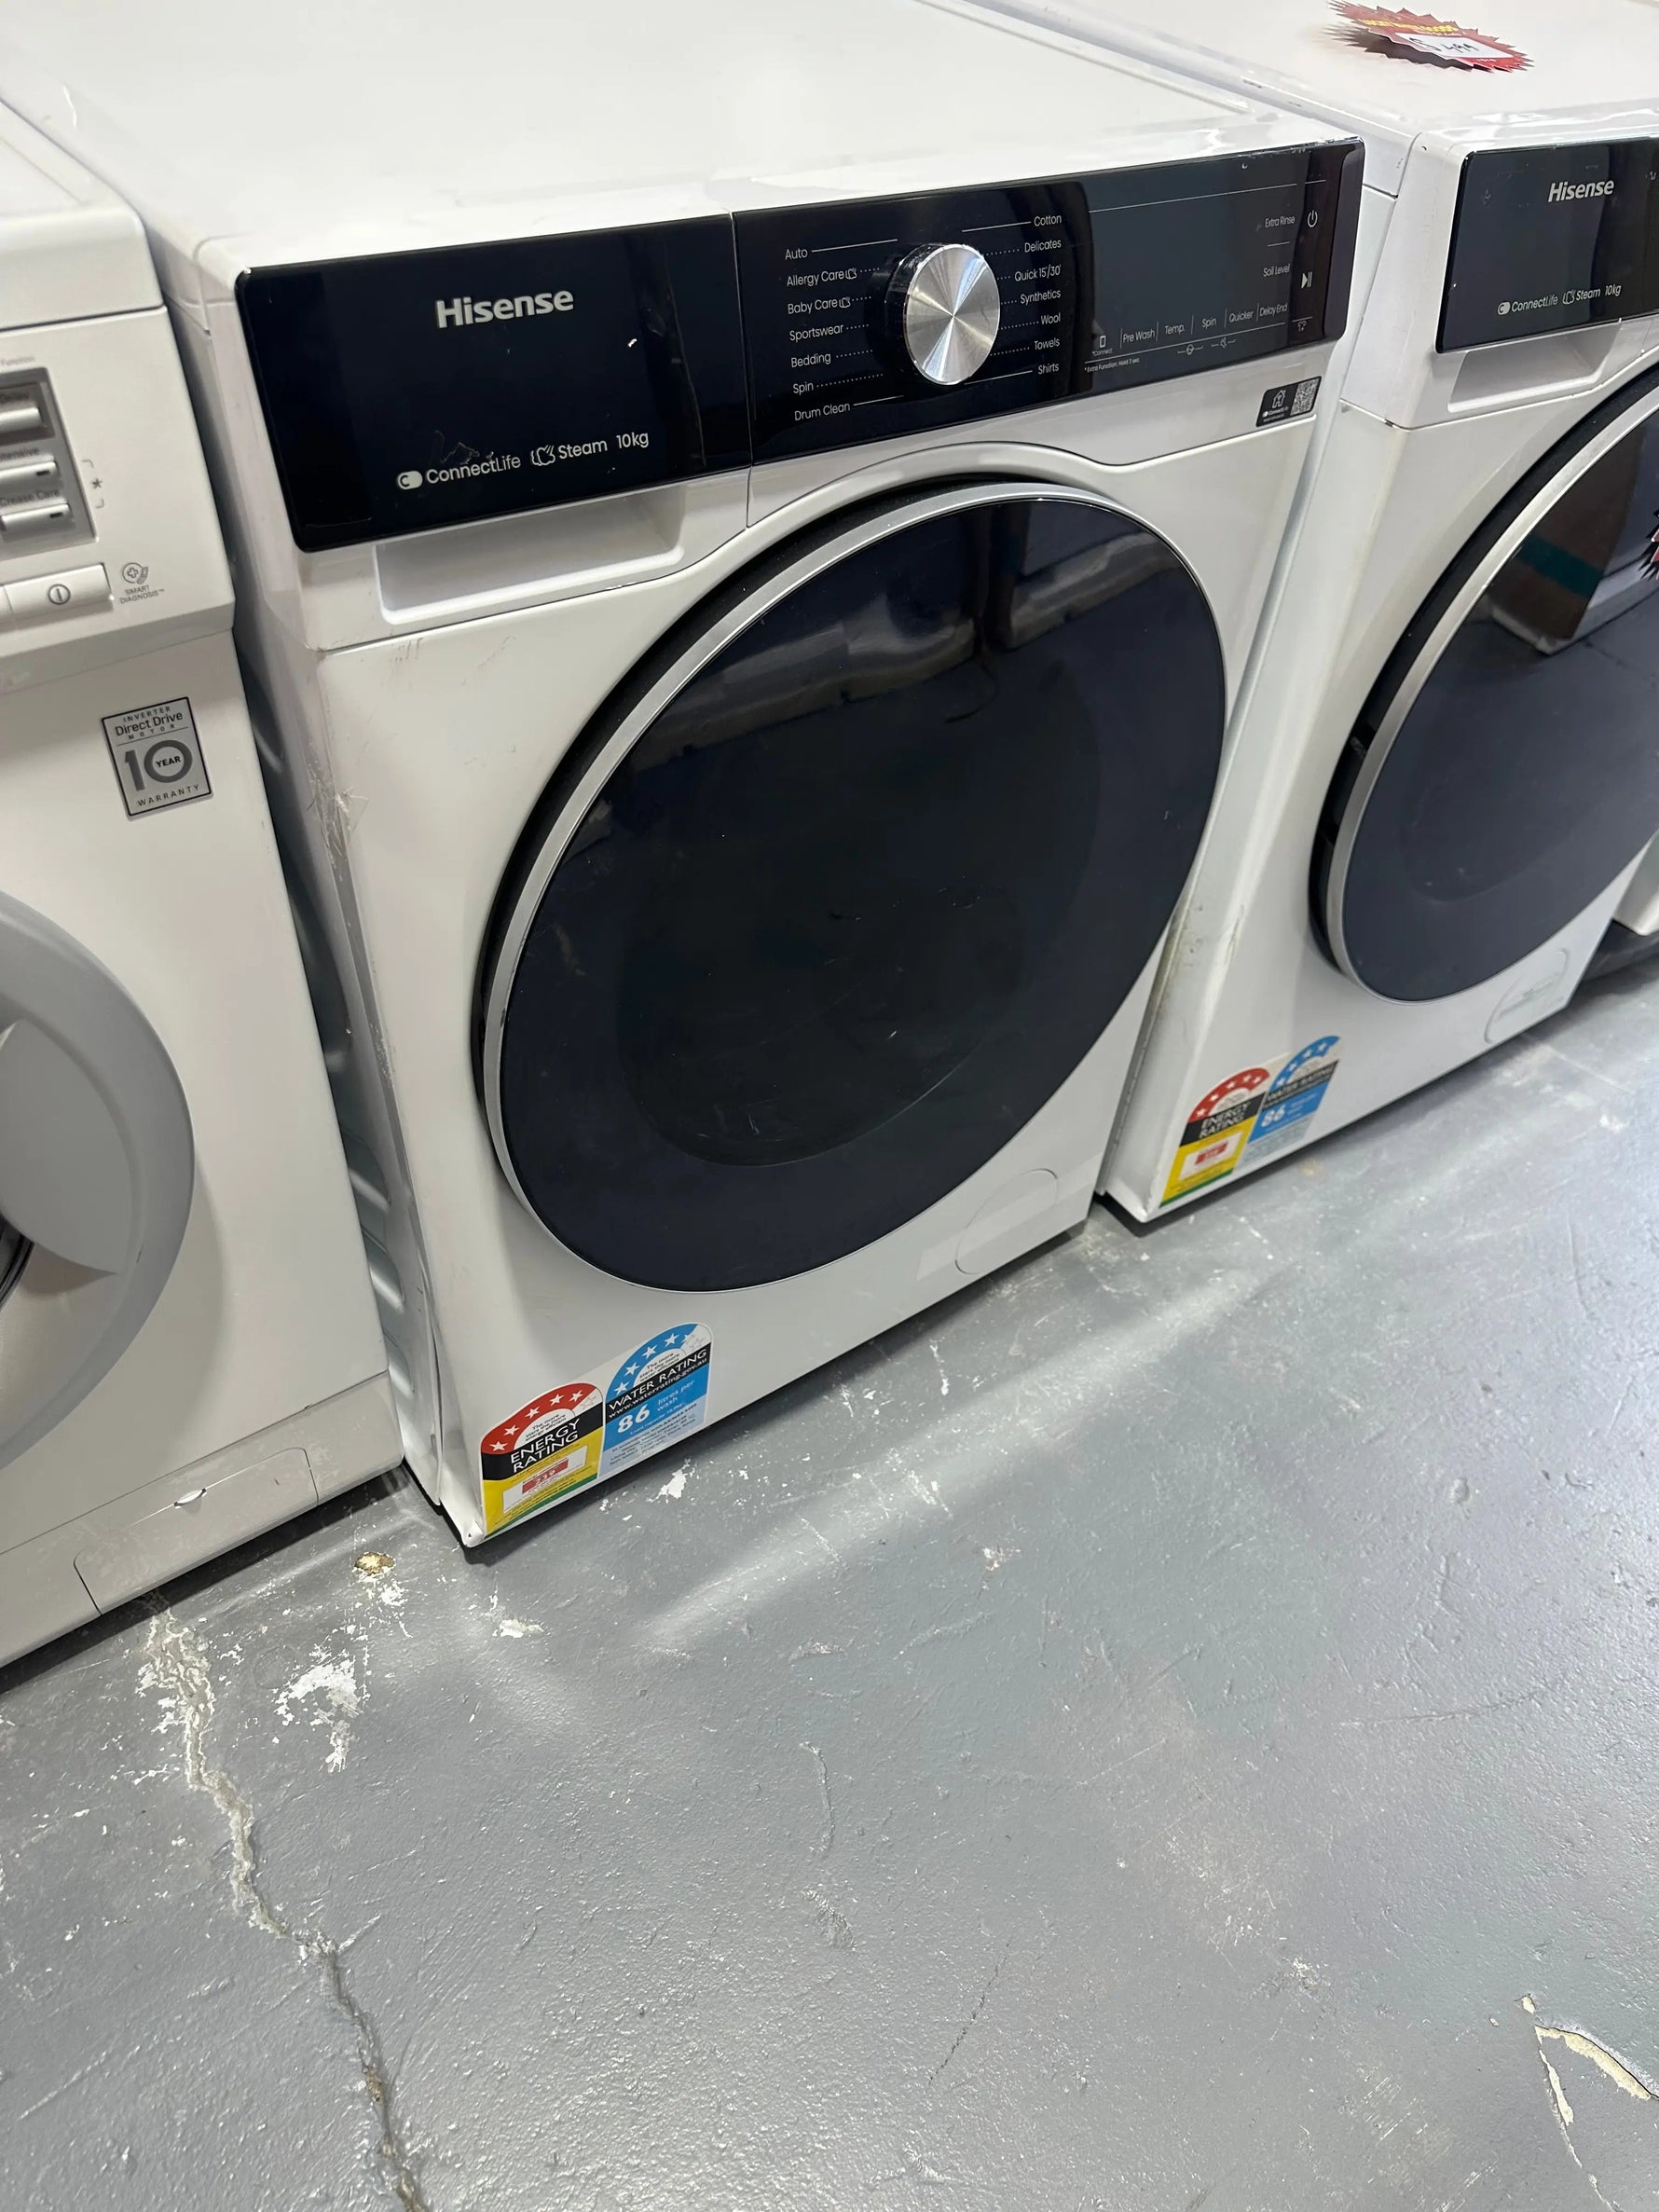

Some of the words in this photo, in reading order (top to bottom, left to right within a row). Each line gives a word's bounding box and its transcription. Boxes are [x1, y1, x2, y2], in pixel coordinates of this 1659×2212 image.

[1548, 180, 1615, 202] Hisense
[1034, 214, 1062, 227] Cotton
[1265, 218, 1280, 228] Extra
[1280, 215, 1296, 226] Rinse
[785, 248, 808, 260] Auto
[1024, 240, 1062, 254] Delicates
[1014, 270, 1038, 282] Quick
[1263, 267, 1275, 277] Soil
[1274, 263, 1291, 275] Level
[787, 272, 819, 287] Allergy
[820, 270, 844, 282] Care
[1020, 289, 1062, 306] Synthetics
[1512, 295, 1559, 312] ConnectLife
[1576, 288, 1601, 301] Steam
[1605, 284, 1622, 297] 10kg
[436, 290, 574, 328] Hisense
[788, 300, 813, 315] Baby
[814, 298, 838, 310] Care
[1259, 305, 1277, 317] Delay
[1276, 303, 1288, 314] End
[1040, 313, 1062, 324] Wool
[1201, 317, 1217, 329] Spin
[1228, 309, 1255, 323] Quicker
[789, 323, 844, 342] Sportswear
[1122, 334, 1135, 344] Pre
[1135, 328, 1156, 341] Wash
[1034, 338, 1061, 351] Towels
[790, 353, 831, 368] Bedding
[1037, 364, 1060, 376] Shirts
[793, 381, 814, 395] Spin
[794, 407, 822, 421] Drum
[822, 401, 851, 416] Clean
[426, 456, 522, 485] ConnectLife
[558, 438, 608, 460] Steam
[615, 432, 650, 450] 10kg
[125, 584, 150, 597] SMART
[123, 706, 171, 723] INVERTER
[115, 720, 151, 736] Direct
[152, 711, 184, 727] Drive
[128, 723, 175, 740] MOTOR
[124, 739, 193, 791] 10
[156, 756, 181, 768] YEAR
[138, 784, 200, 807] WARRANTY
[609, 1381, 654, 1410] WATER
[659, 1348, 707, 1383] RATING
[657, 1397, 679, 1412] wash
[658, 1390, 679, 1406] litres
[617, 1404, 651, 1434] 86
[511, 1418, 580, 1464] ENERGY
[514, 1431, 579, 1473] RATING
